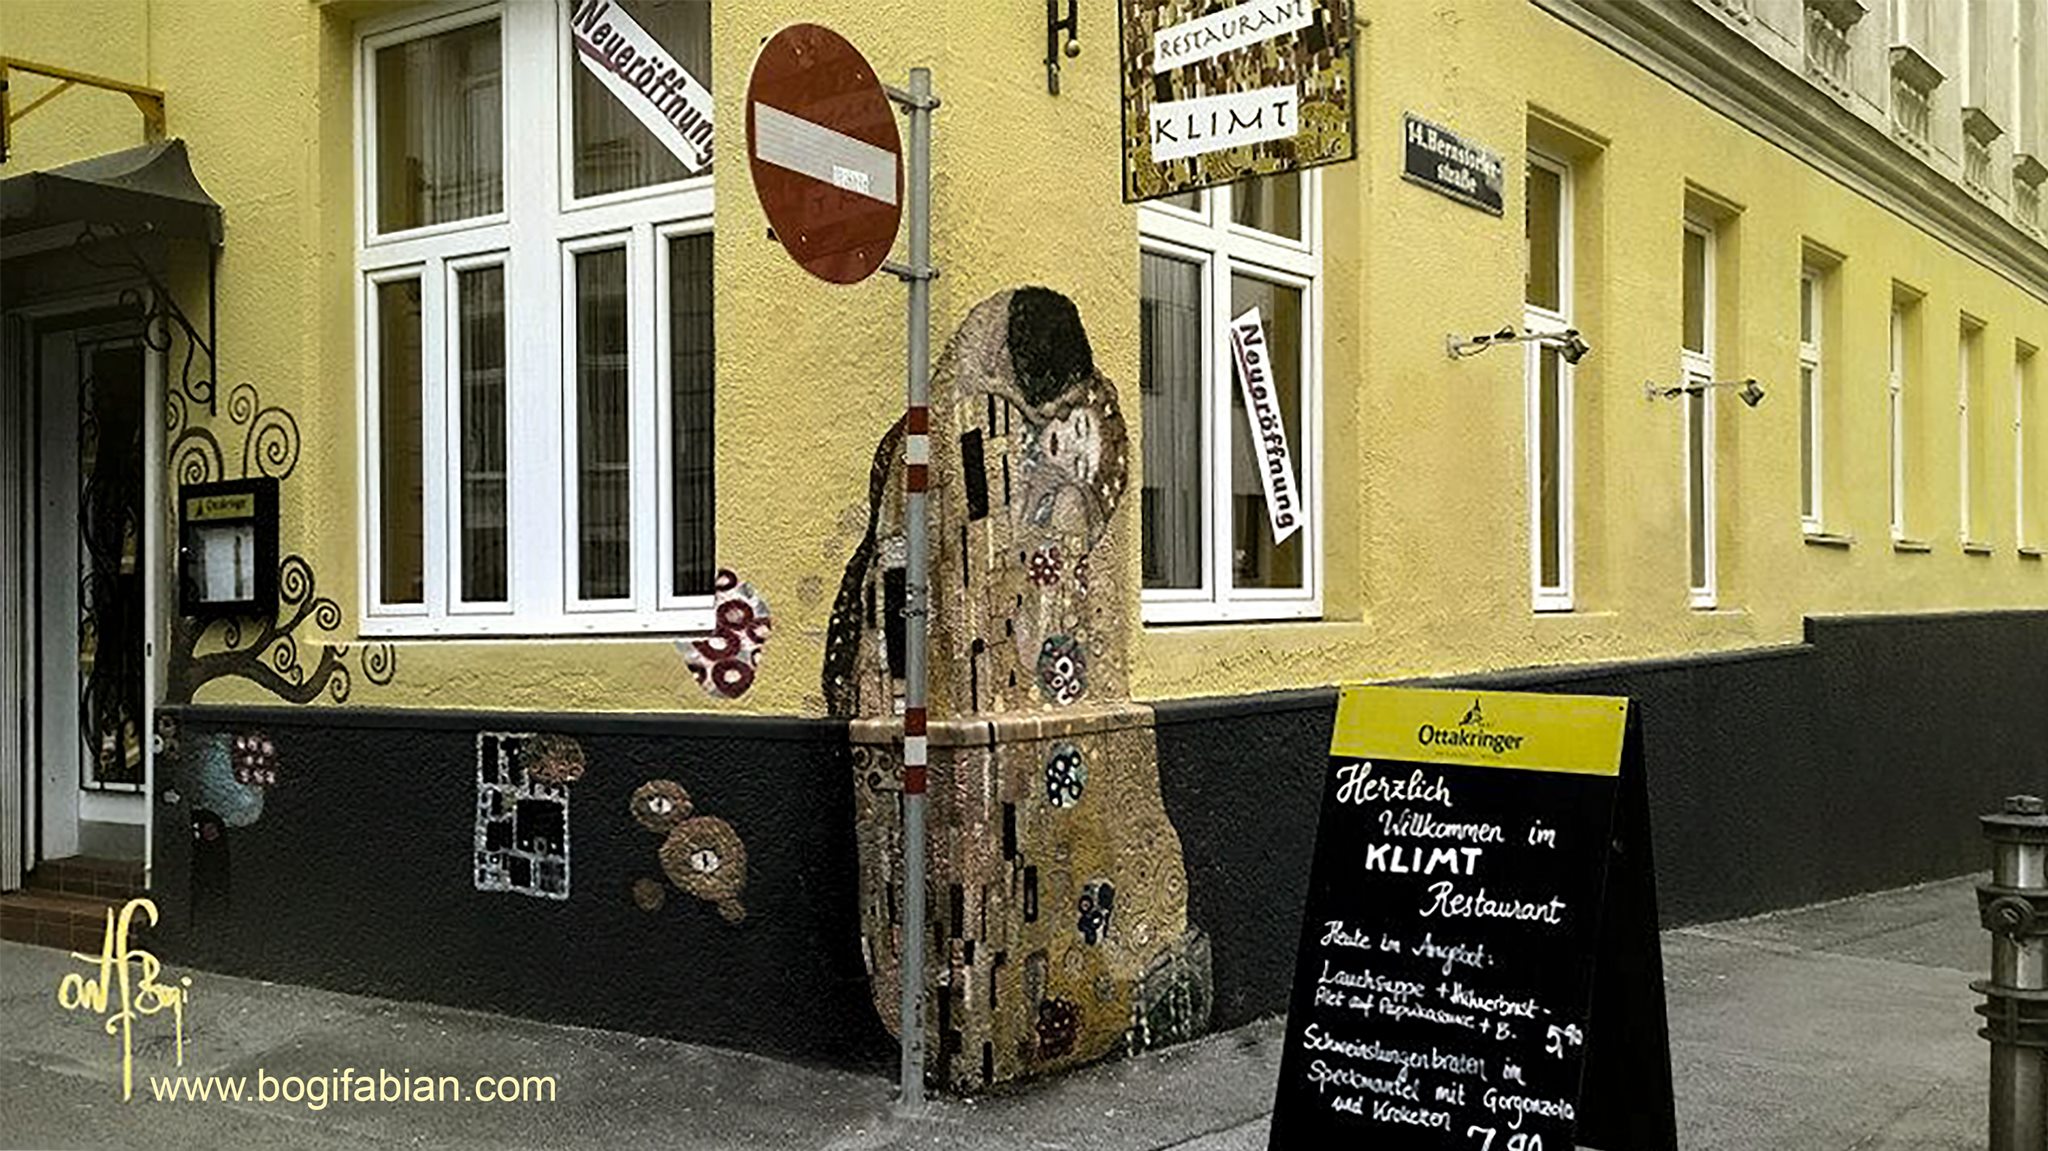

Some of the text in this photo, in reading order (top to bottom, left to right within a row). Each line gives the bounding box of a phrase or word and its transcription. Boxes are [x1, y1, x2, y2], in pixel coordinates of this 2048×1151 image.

[1160, 0, 1305, 58] RESTAURANT
[1156, 101, 1289, 143] KLIMT
[1240, 323, 1295, 529] Neueröffnung
[1418, 724, 1523, 754] Ottakringer
[1336, 762, 1453, 807] Herzlich
[1378, 808, 1556, 848] Willkommen im
[1364, 843, 1483, 876] KLIMT
[1418, 881, 1567, 925] Restaurant
[1320, 920, 1372, 949] Heute
[1435, 1082, 1466, 1106] mit
[1483, 1087, 1575, 1130] Gorgonzola
